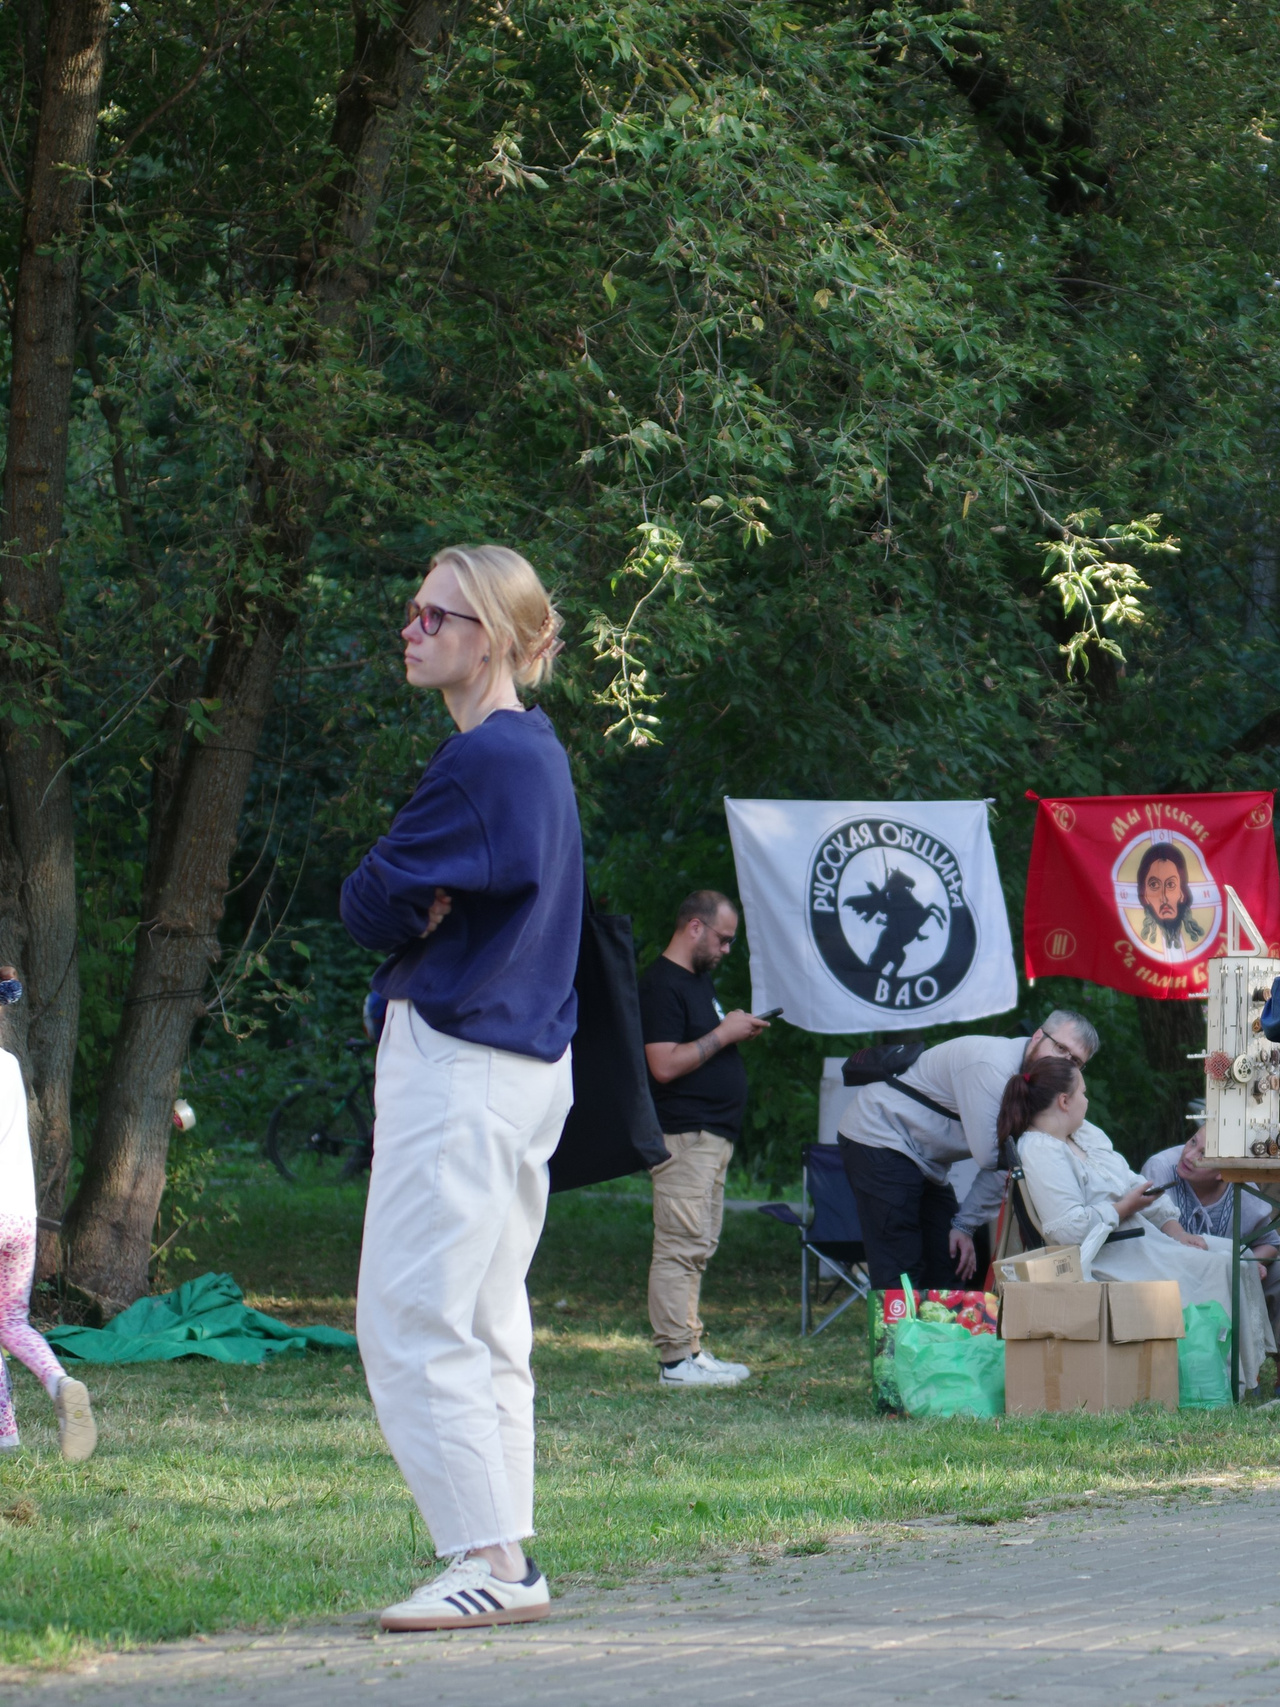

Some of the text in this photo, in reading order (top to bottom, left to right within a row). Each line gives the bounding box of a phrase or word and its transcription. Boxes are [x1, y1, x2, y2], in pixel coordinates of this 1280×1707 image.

[813, 822, 964, 912] РУССКАЯ ОБЩИНА
[875, 975, 938, 1006] ВАО
